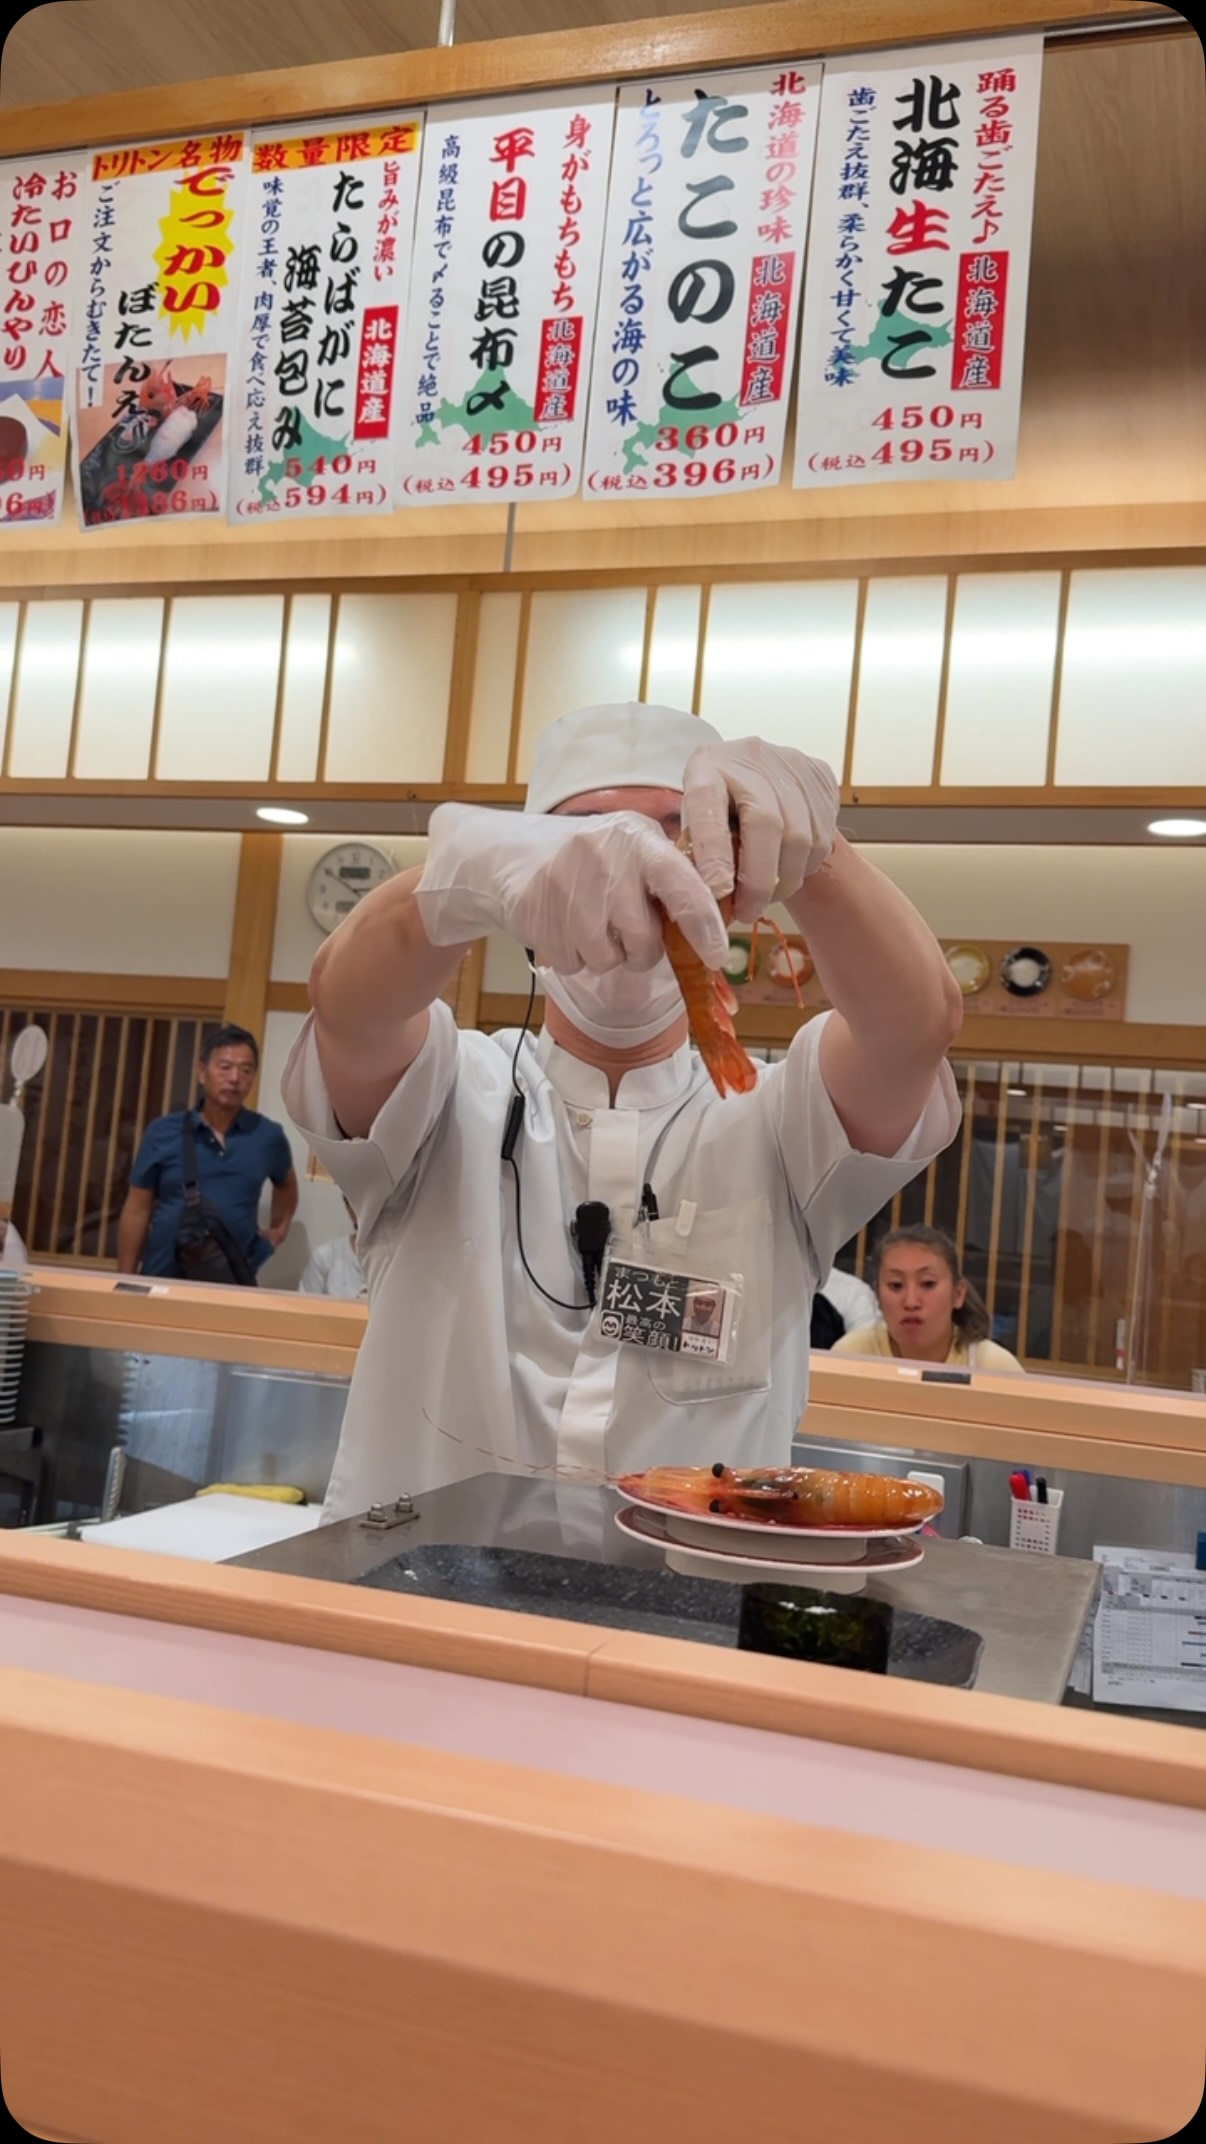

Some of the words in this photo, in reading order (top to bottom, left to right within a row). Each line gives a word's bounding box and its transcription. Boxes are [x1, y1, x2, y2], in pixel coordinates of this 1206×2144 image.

[92, 135, 243, 181] トリトン名物
[254, 128, 412, 170] 数量限定
[551, 113, 593, 313] 身がもちもち
[757, 71, 807, 244] 北海道の珍味
[2, 172, 47, 371] 冷たいひんやり
[35, 171, 78, 379] お口の恋人
[163, 166, 235, 313] でっかい
[373, 161, 401, 281] 旨みが濃い
[465, 126, 537, 416] 平目の昆布〆
[606, 88, 664, 426] とろっと広がる海の味
[662, 88, 749, 411] たこのこ
[824, 87, 877, 387] 歯ごたえ抜群、柔らかく甘くて美味
[880, 75, 962, 380] 北海生たこ
[82, 181, 120, 408] ご注文からむきたて!
[244, 176, 284, 475] 味覚の王者、肉厚で食べ応え抜群
[272, 244, 322, 450] 海苔包み
[314, 170, 365, 419] たらばがに
[745, 257, 786, 402] 北海道産
[960, 254, 999, 388] 北海道産
[357, 317, 393, 424] 北海道産
[541, 319, 576, 420] 北海道産
[871, 405, 983, 431] 450円
[115, 458, 209, 484] 1260円
[236, 483, 387, 515] (税込594円)
[284, 454, 377, 478] 540円
[403, 462, 571, 493] (税込495円)
[461, 431, 562, 456] 450円
[588, 454, 774, 491] (税込396円)
[655, 422, 766, 452] 360円
[808, 439, 995, 473] (税込495円)
[606, 1280, 681, 1319] 松本
